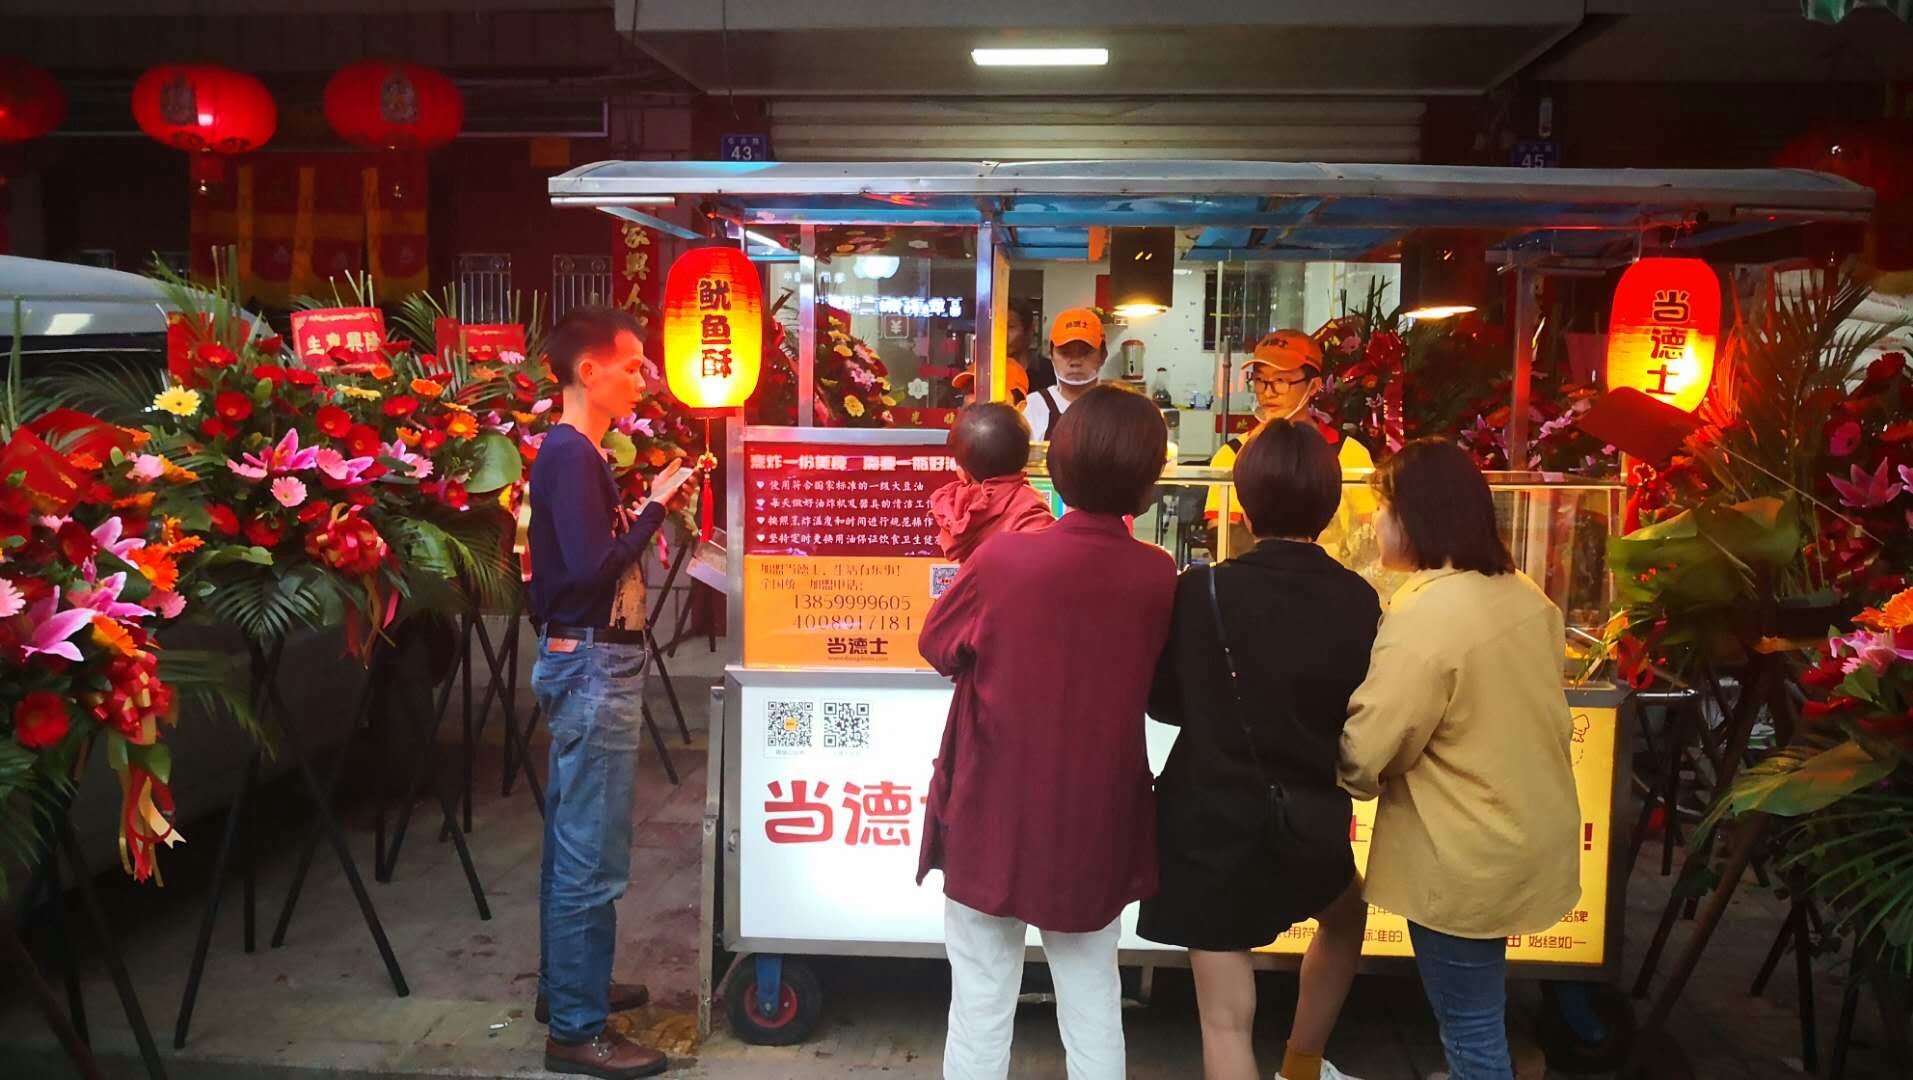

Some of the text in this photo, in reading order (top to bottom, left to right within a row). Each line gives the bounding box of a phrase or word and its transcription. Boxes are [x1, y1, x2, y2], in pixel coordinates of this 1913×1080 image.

[699, 279, 731, 378] 鱿鱼酥
[1645, 289, 1689, 396] 当德士
[827, 637, 888, 655] 当德士
[764, 780, 927, 846] 当德
[1529, 935, 1586, 949] 始终如一
